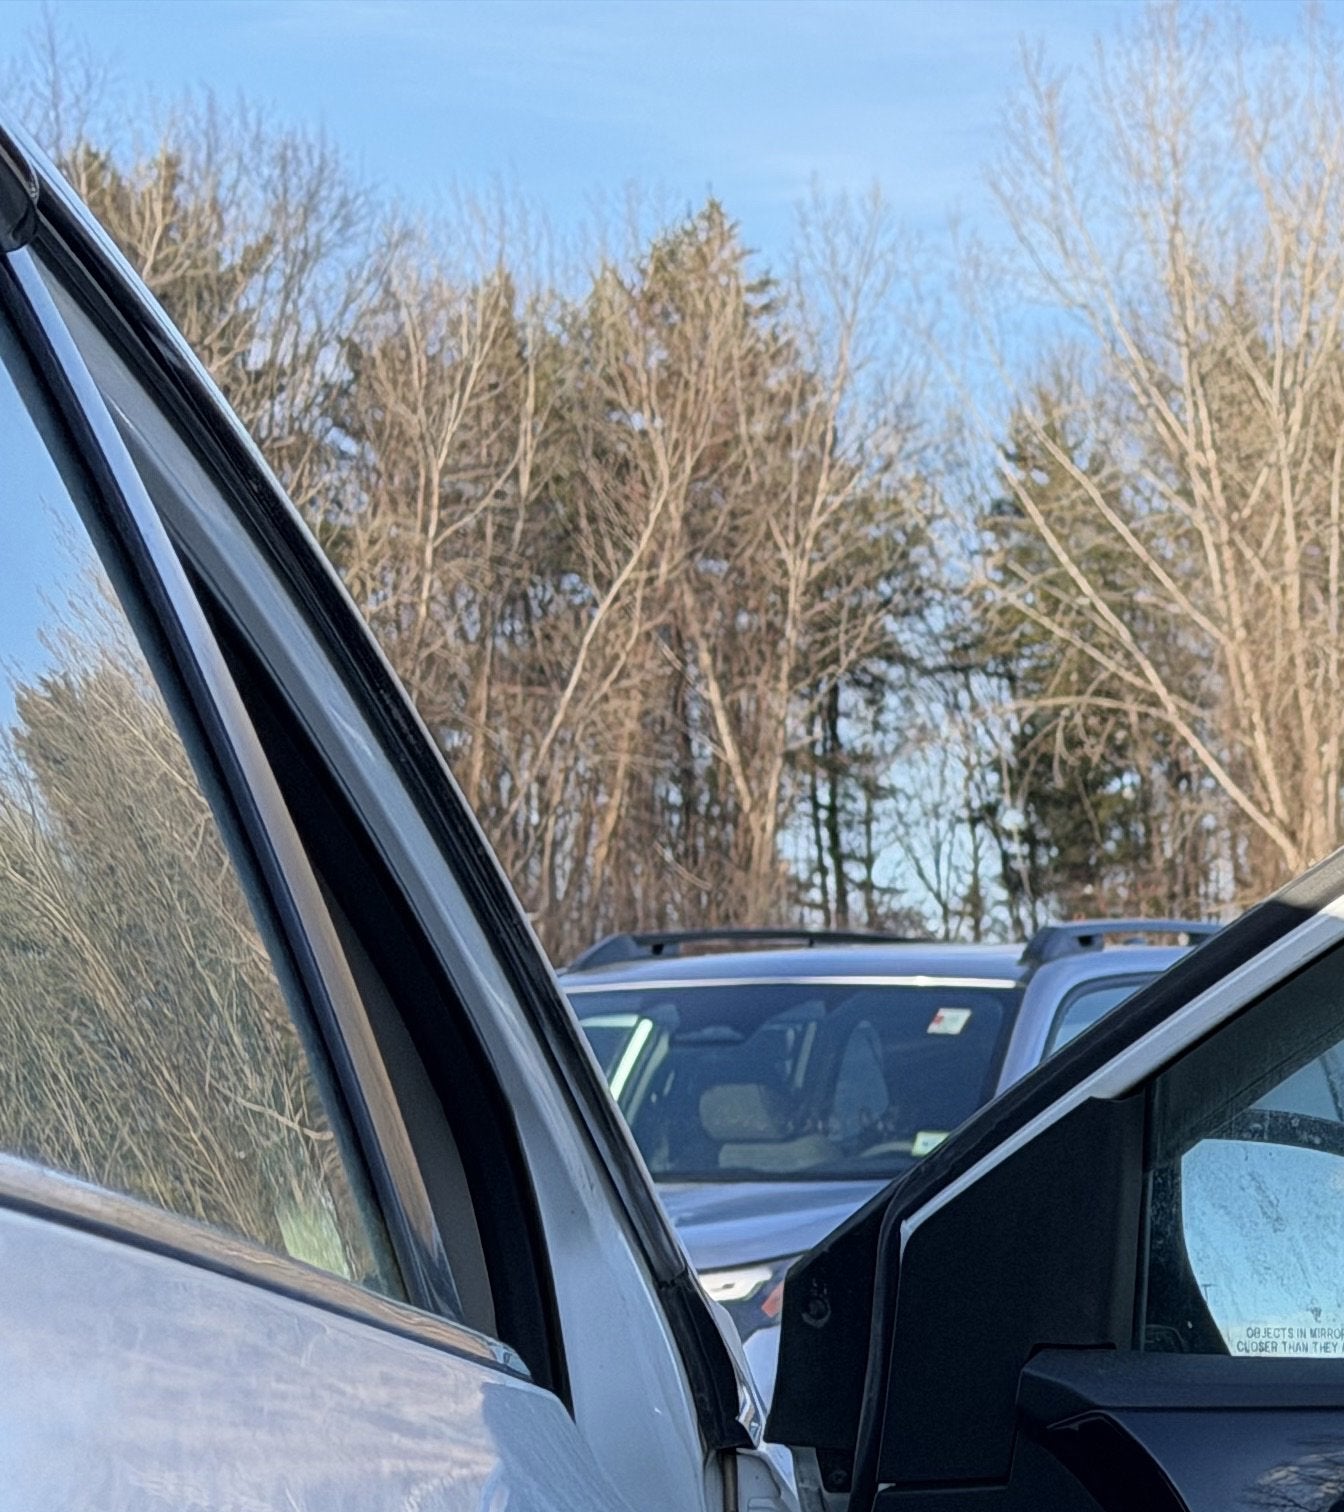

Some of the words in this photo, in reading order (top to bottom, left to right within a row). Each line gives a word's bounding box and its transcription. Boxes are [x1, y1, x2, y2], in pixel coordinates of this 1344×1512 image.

[1246, 1327, 1294, 1339] OBJECTS
[1296, 1327, 1307, 1338] IN
[1236, 1340, 1278, 1353] CLOSER
[1282, 1341, 1309, 1353] THAN
[1313, 1341, 1339, 1353] THEY
